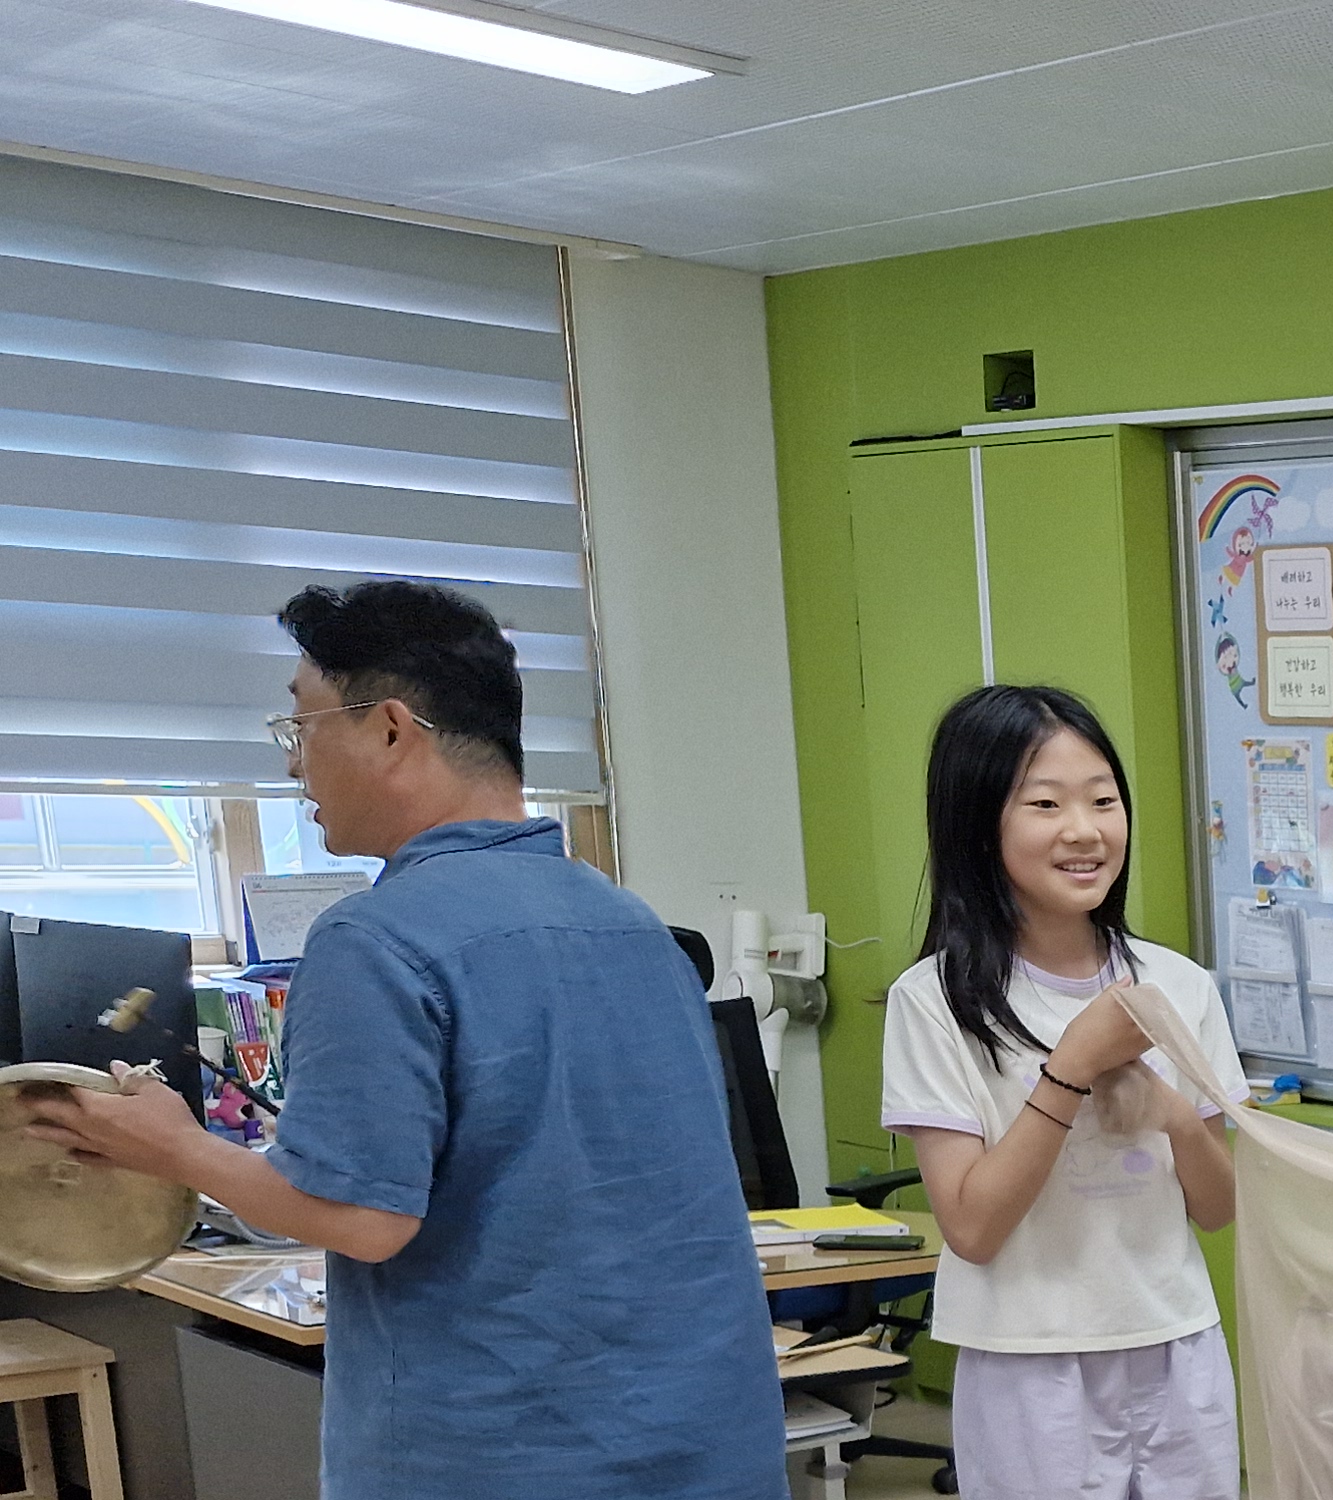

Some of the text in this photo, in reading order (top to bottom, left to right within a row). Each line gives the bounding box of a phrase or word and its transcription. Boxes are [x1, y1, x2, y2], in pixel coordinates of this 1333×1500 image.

[1275, 595, 1321, 611] 나누는 우리
[1310, 682, 1326, 697] 우리
